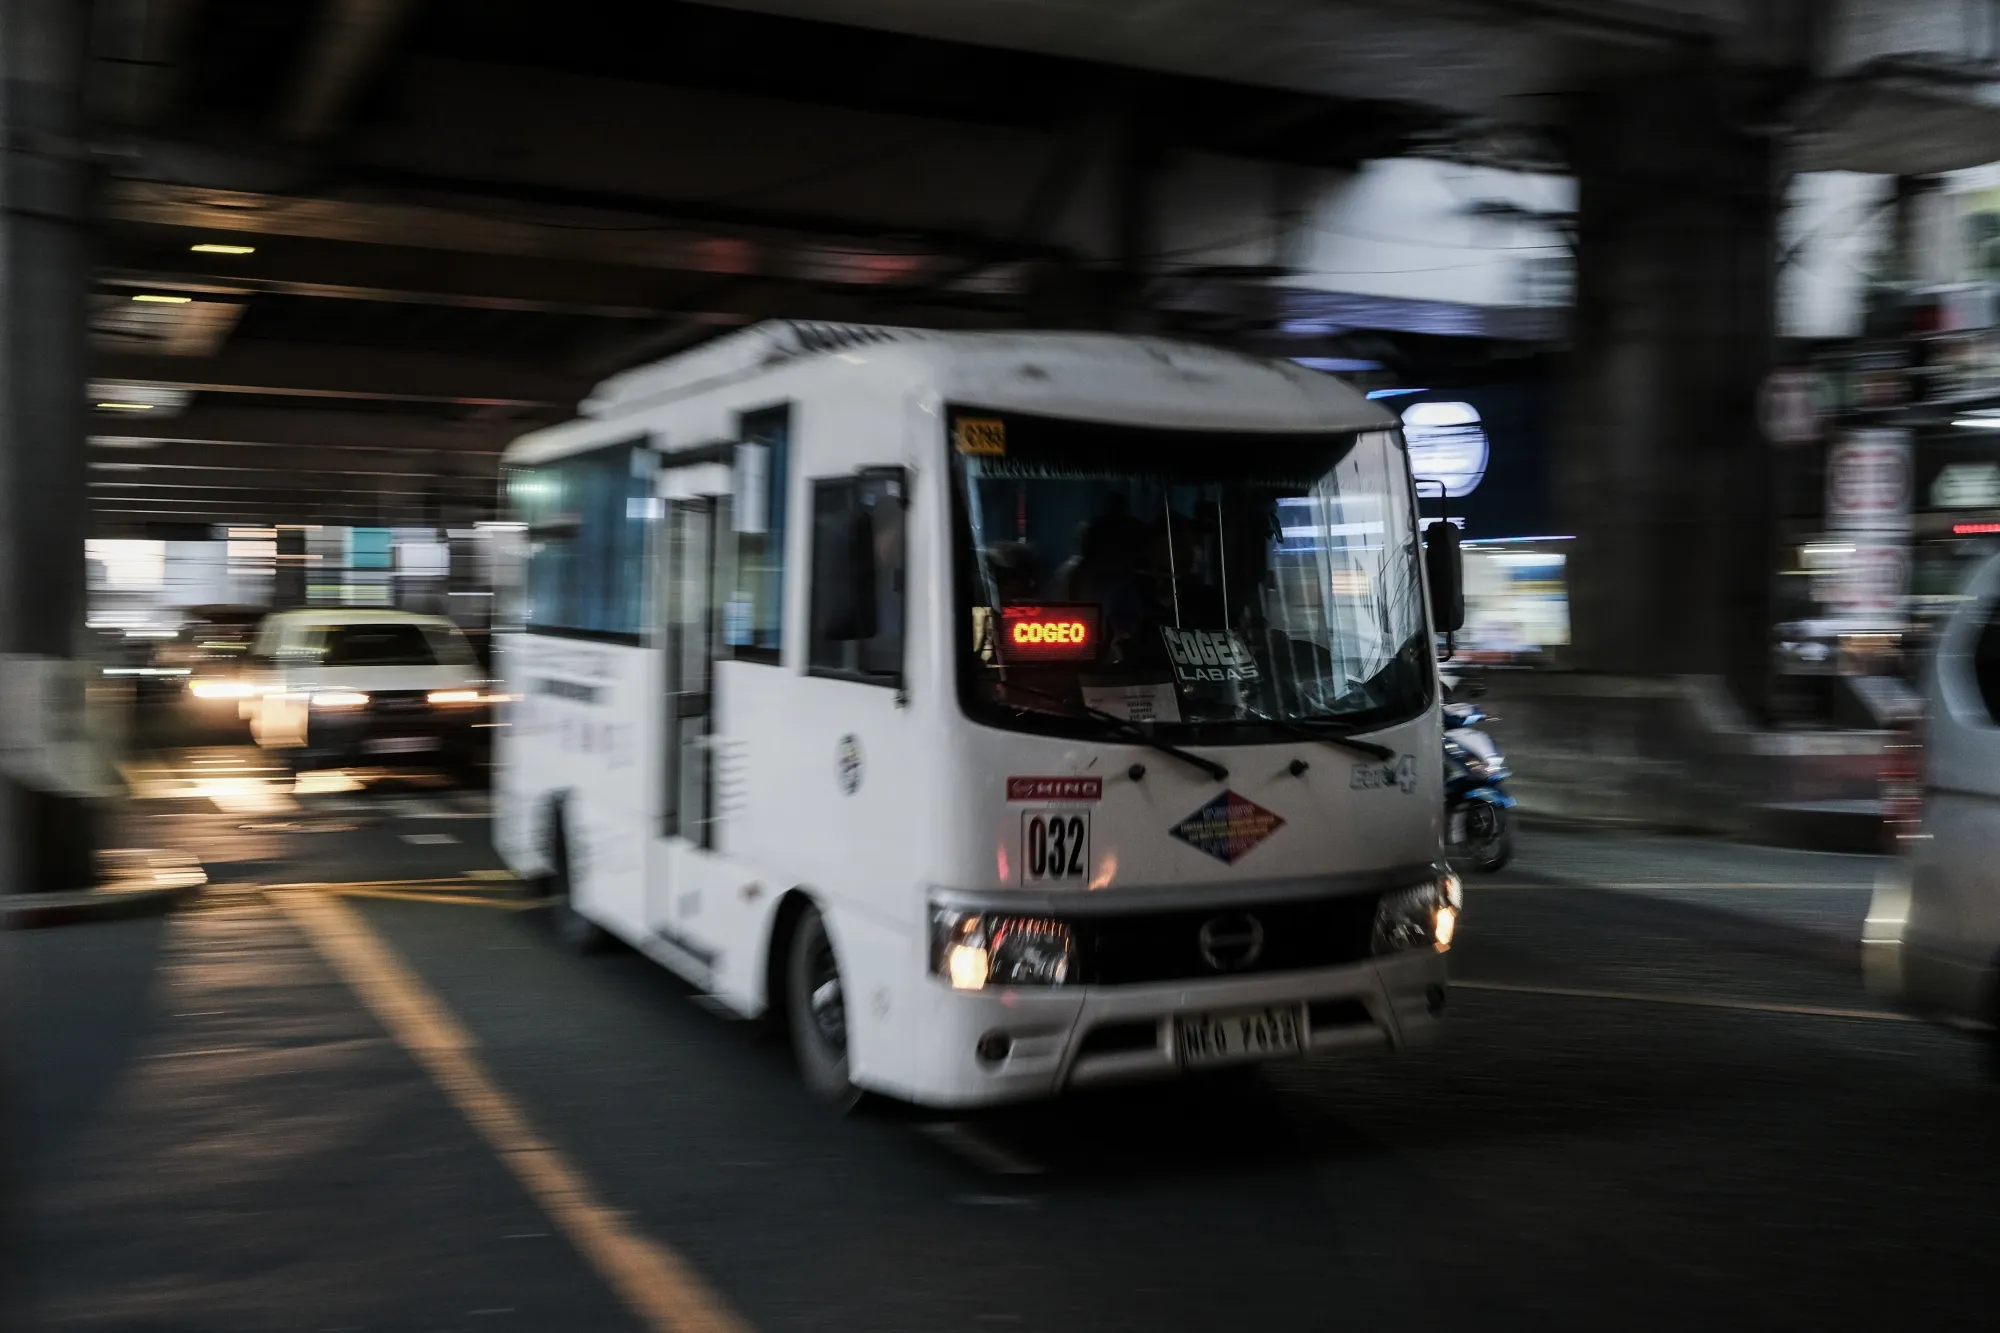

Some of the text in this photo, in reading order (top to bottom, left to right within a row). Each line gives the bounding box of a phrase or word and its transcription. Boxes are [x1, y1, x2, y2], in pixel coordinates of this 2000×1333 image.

[1013, 622, 1086, 643] COGEO
[1164, 626, 1252, 666] COGEO
[1177, 664, 1260, 681] LABAS
[1036, 781, 1098, 797] HINO
[1028, 816, 1085, 879] 032
